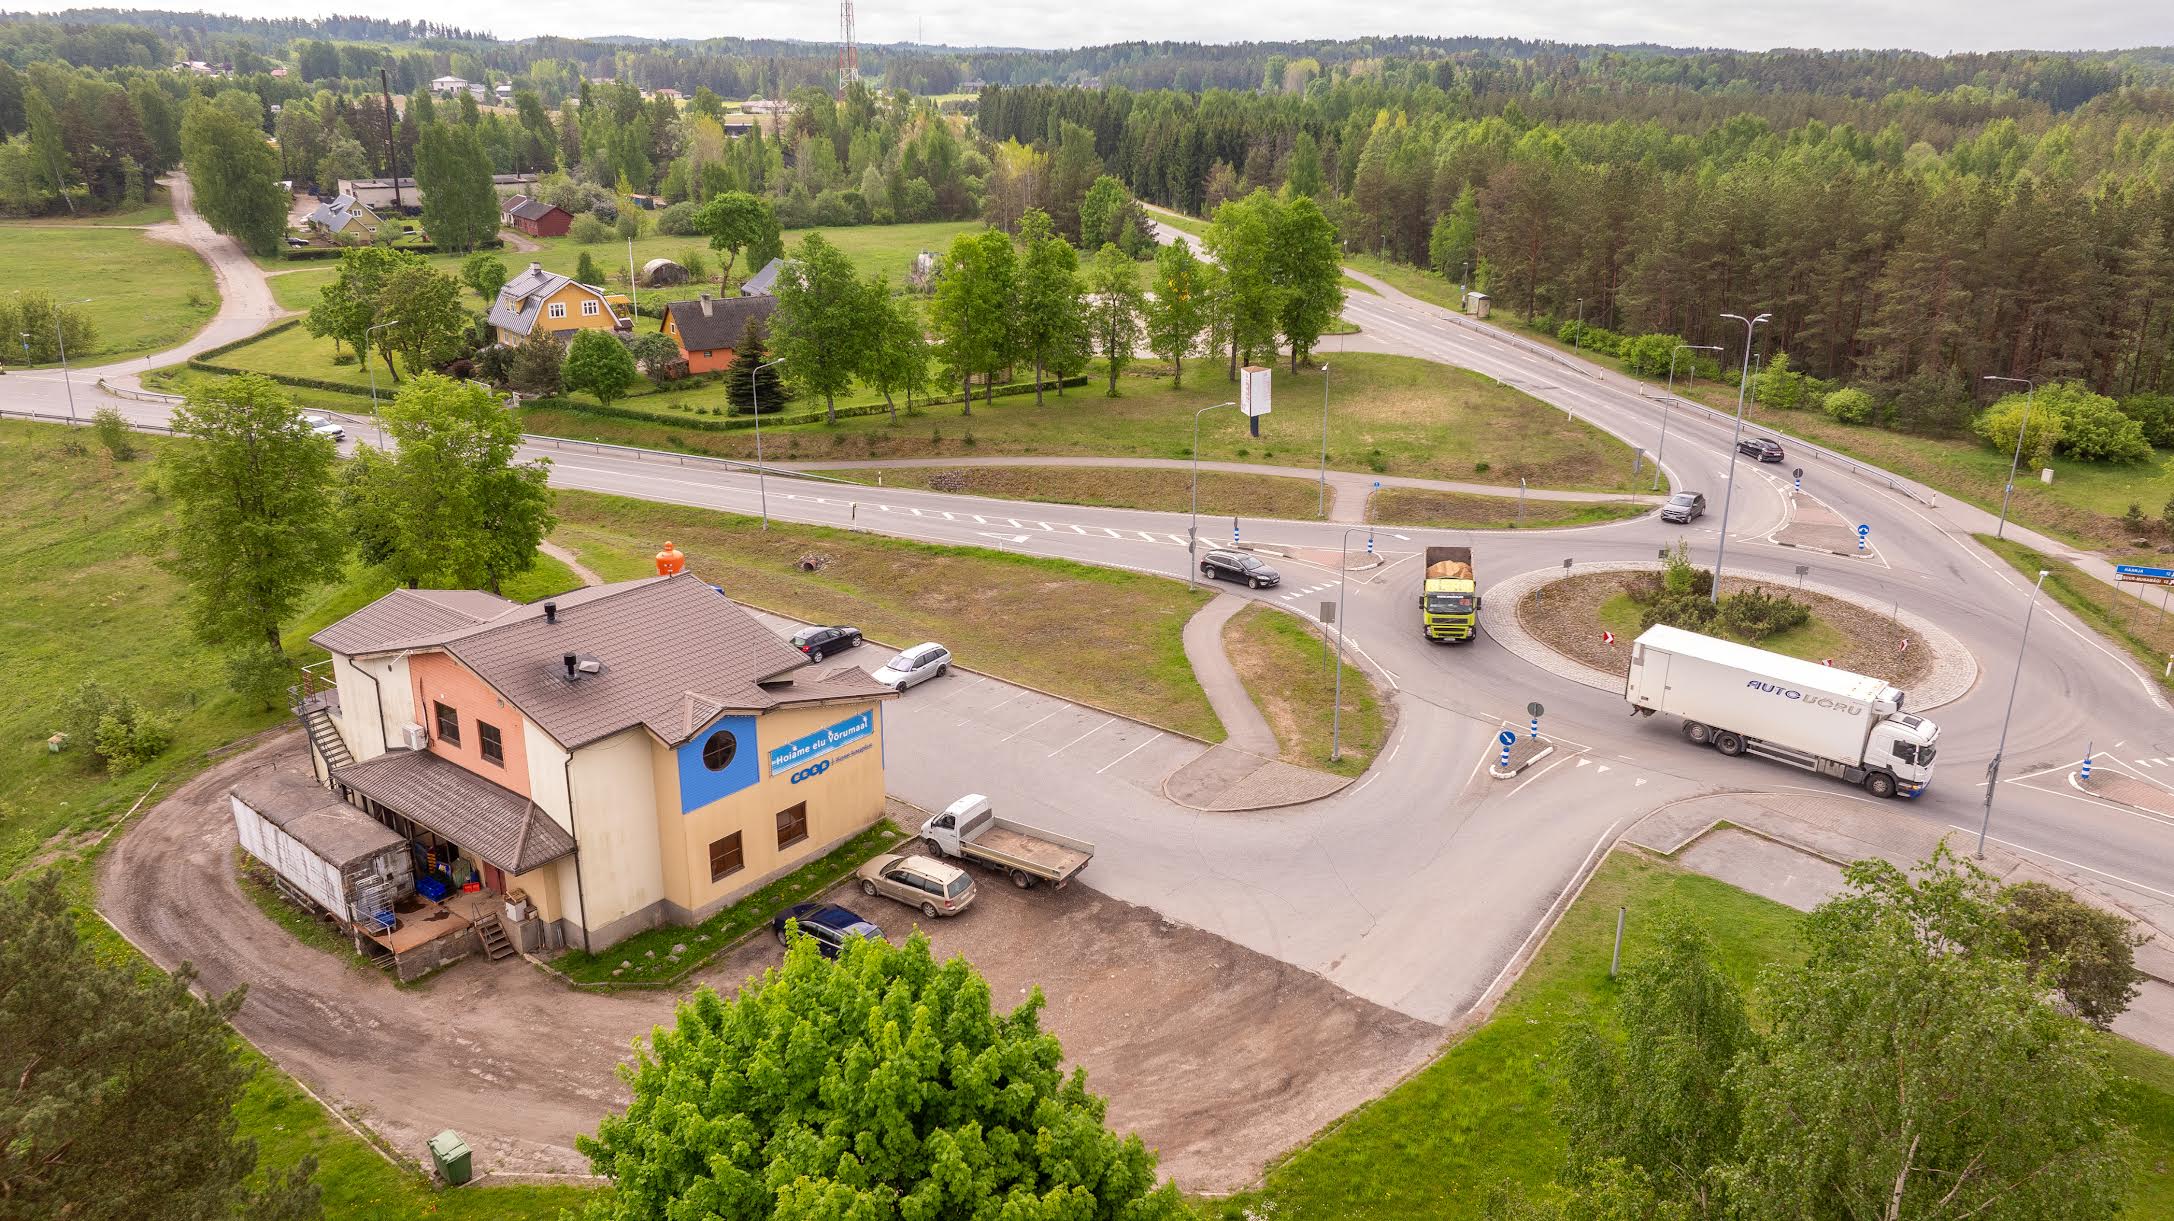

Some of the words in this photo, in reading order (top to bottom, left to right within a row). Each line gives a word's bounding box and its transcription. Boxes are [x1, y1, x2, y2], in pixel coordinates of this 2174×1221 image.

[1747, 680, 1801, 700] AUTO
[776, 746, 810, 765] Hoiame
[812, 739, 826, 750] elu
[828, 717, 868, 743] Võrumaal
